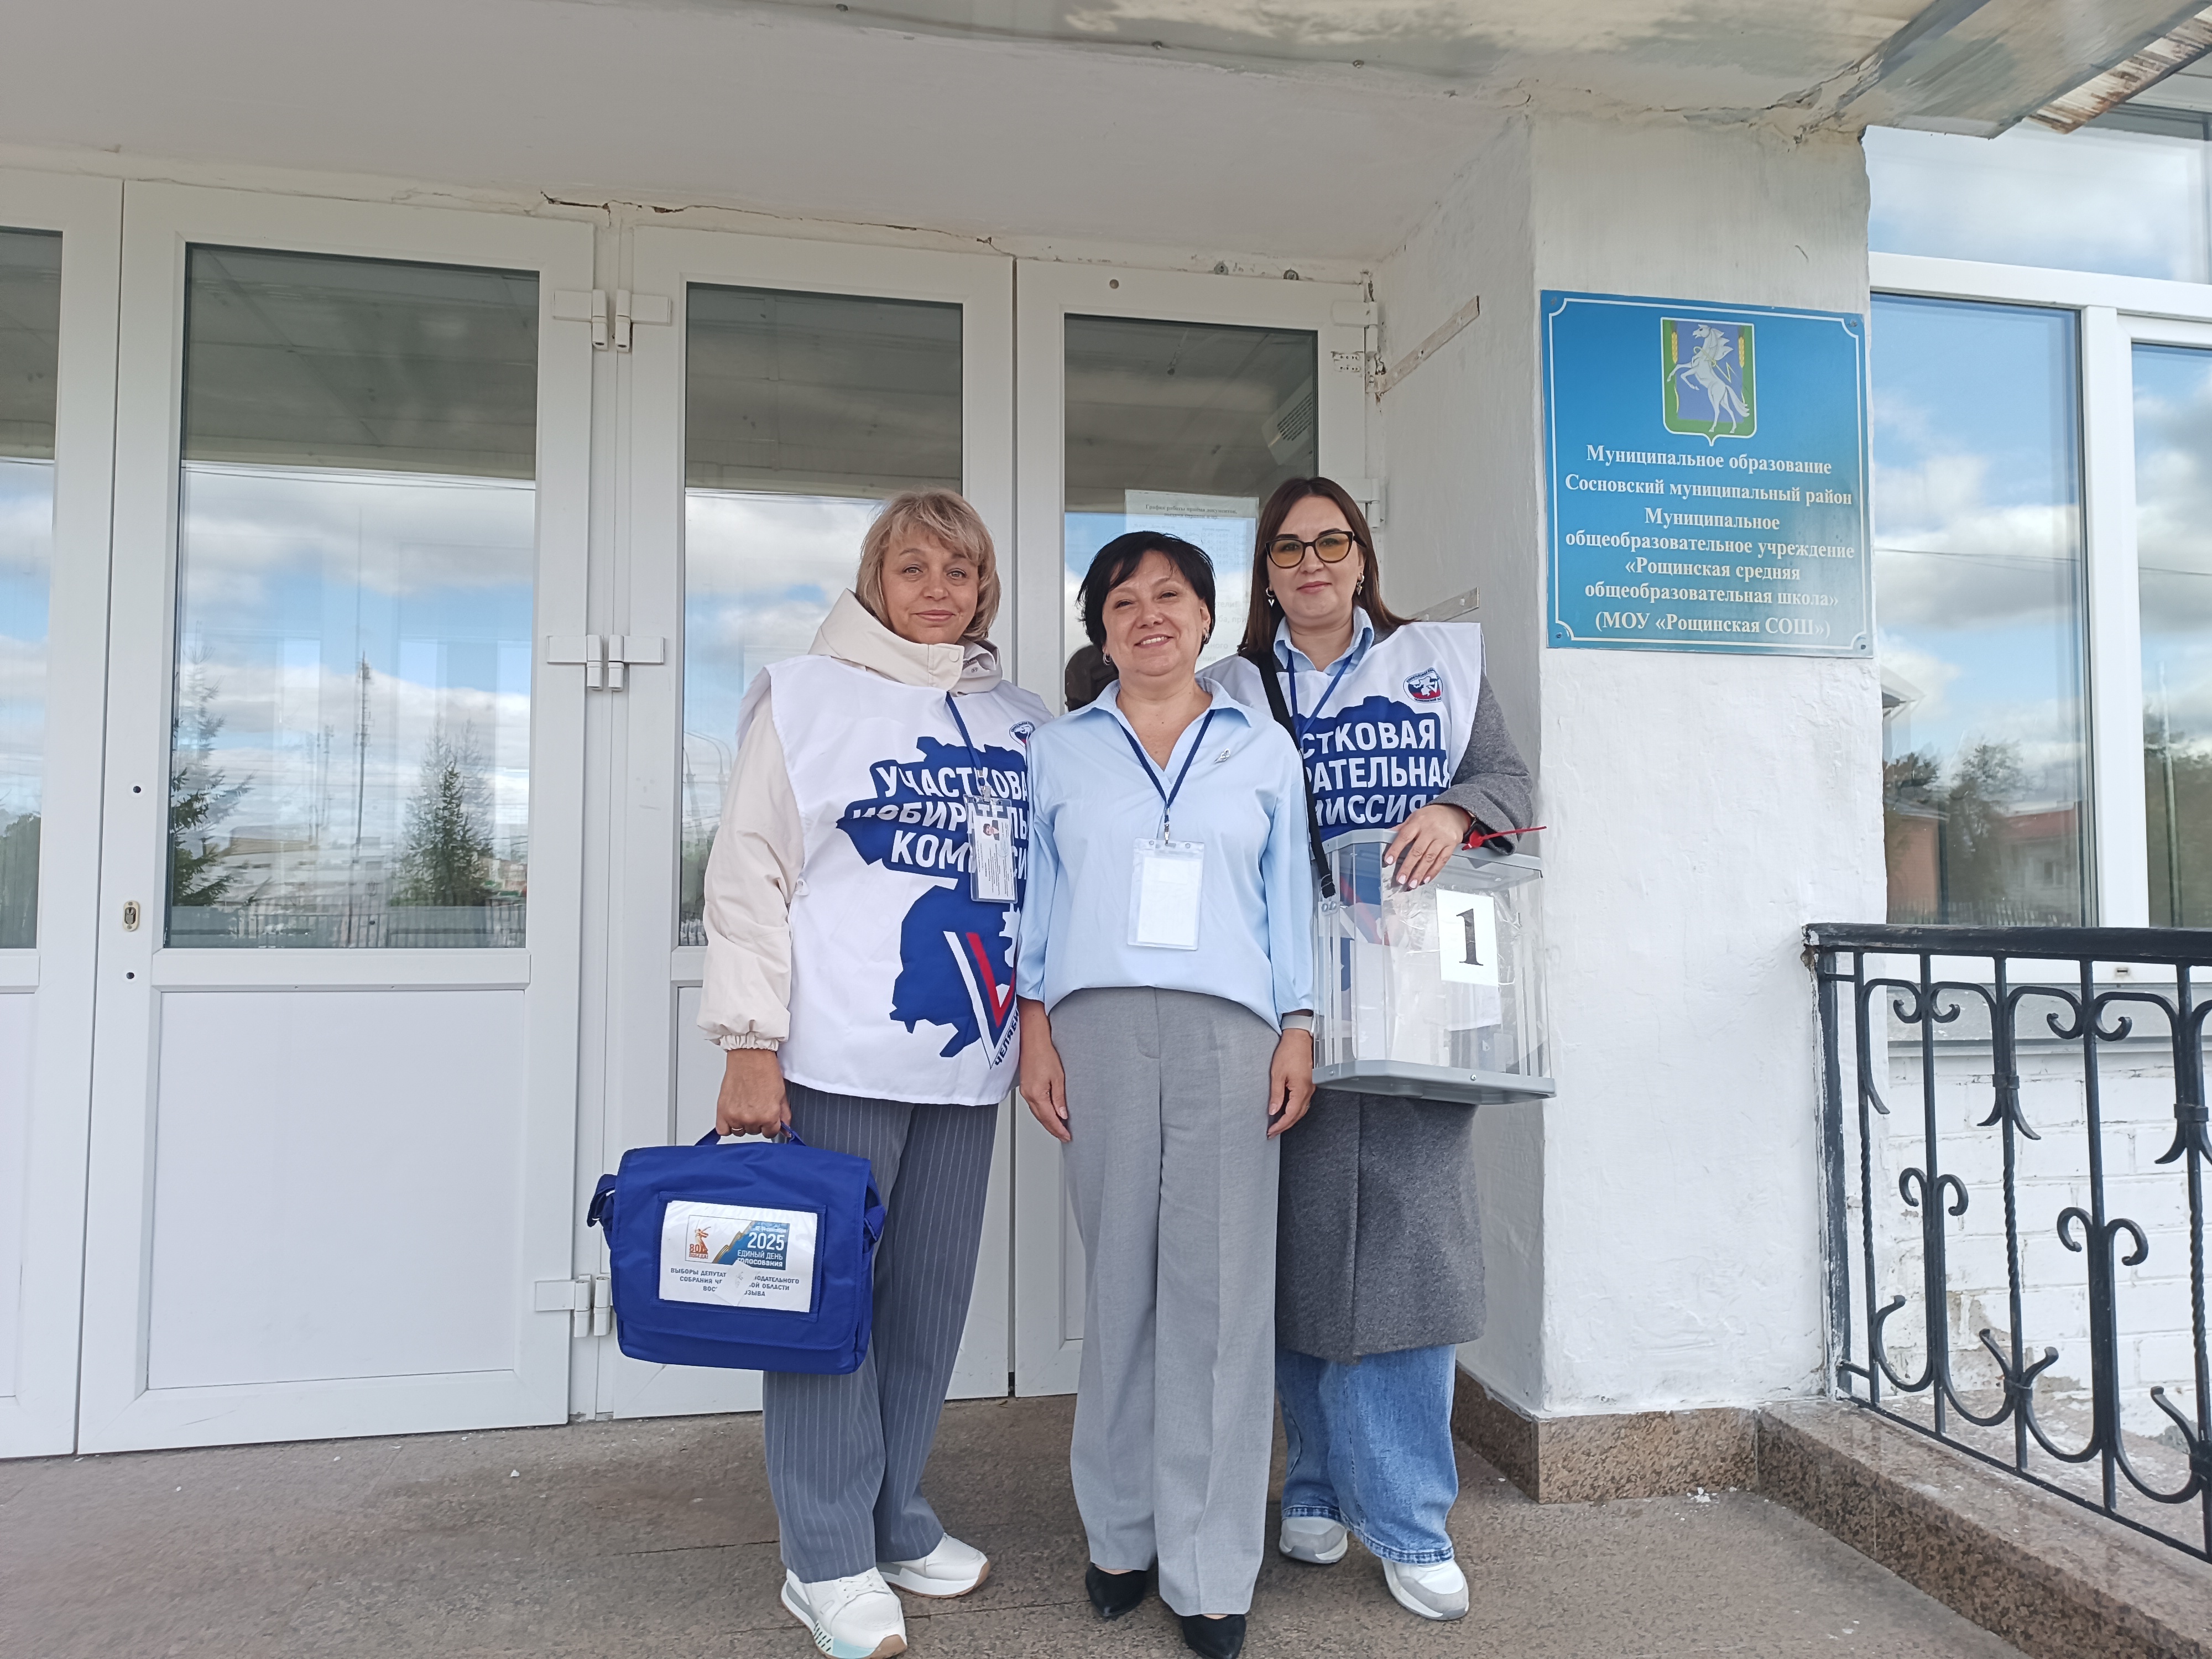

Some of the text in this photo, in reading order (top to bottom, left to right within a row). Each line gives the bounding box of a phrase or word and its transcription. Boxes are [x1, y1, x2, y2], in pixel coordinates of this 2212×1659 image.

[1587, 444, 1832, 474] Муниципальное образование
[1566, 474, 1852, 506] Сосновский муниципальный район
[1645, 507, 1780, 530] Муниципальное
[1566, 531, 1855, 559] общеобразовательное учреждение
[1625, 556, 1800, 582] «Рощинская средняя
[1585, 582, 1839, 607] общеобразовательная школа»
[1595, 611, 1830, 639] (МОУ «Рощинская СОШ»)
[1456, 908, 1484, 966] 1
[737, 1249, 783, 1260] ЕДИНЫЙ ДЕНЬ
[747, 1232, 785, 1251] 2025
[680, 1276, 712, 1284] СОБРАНИЯ
